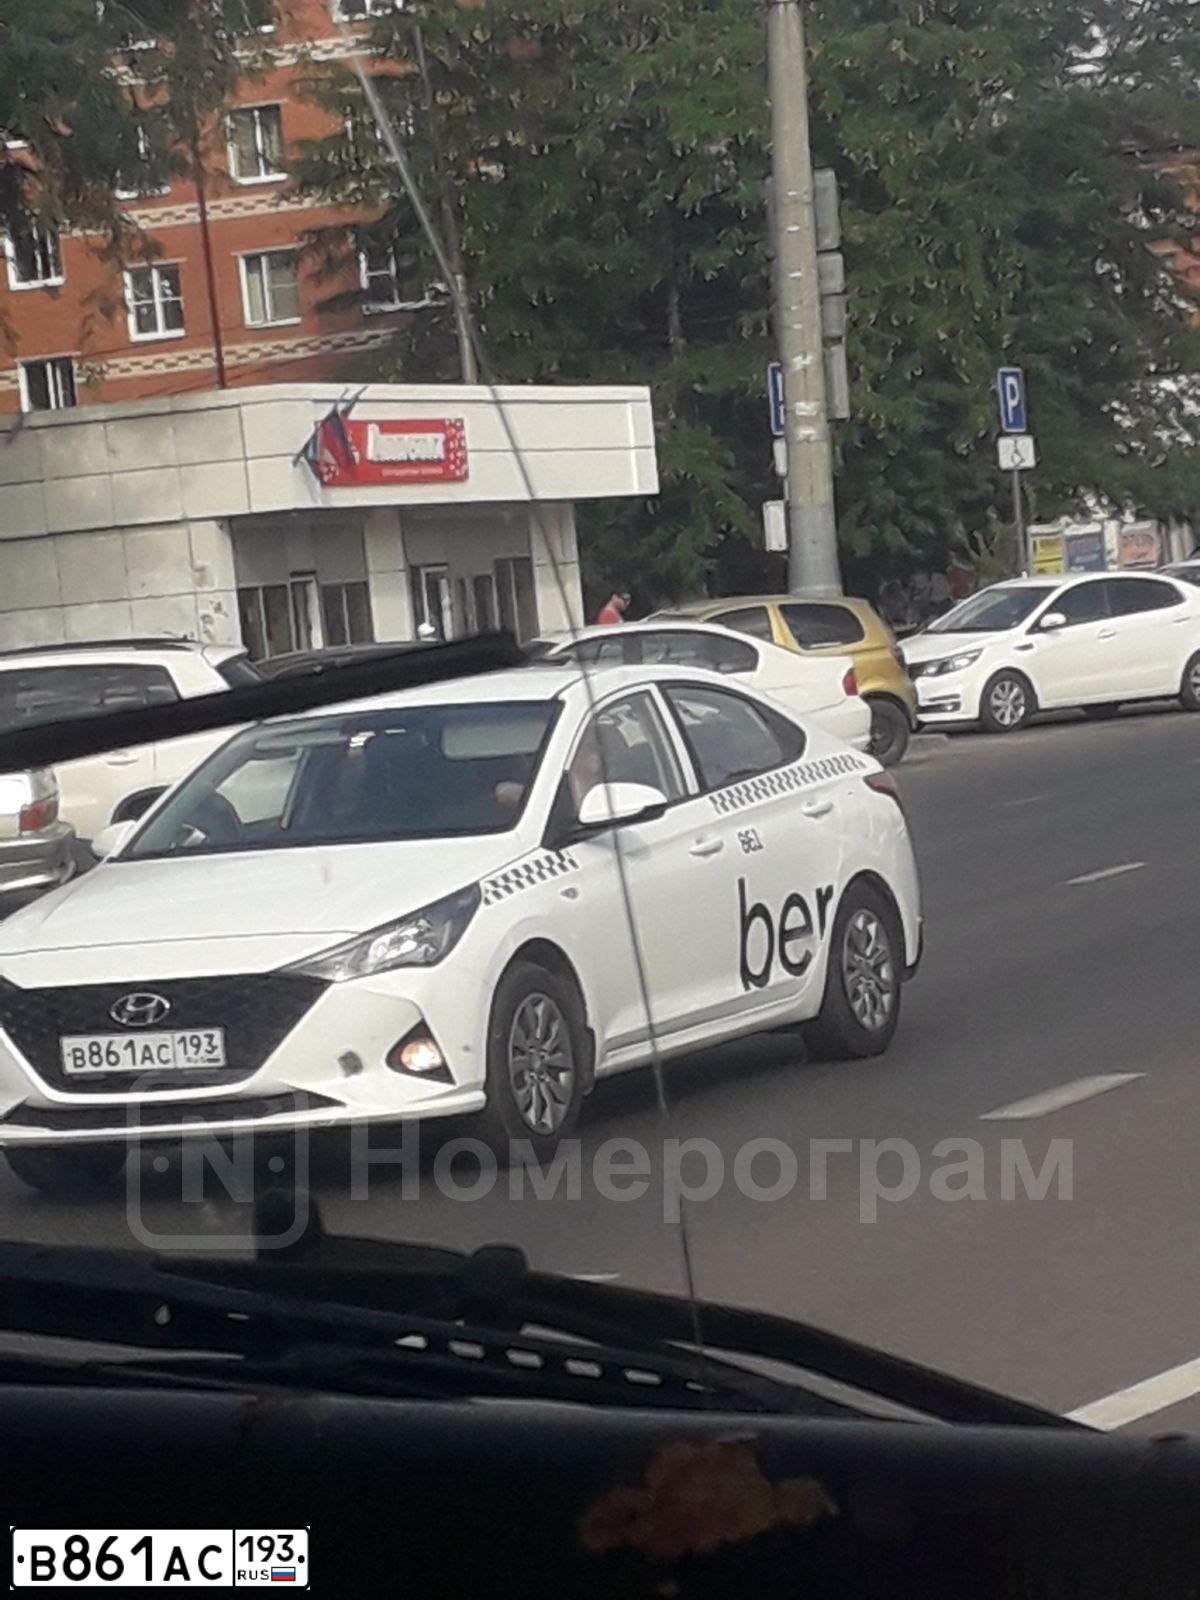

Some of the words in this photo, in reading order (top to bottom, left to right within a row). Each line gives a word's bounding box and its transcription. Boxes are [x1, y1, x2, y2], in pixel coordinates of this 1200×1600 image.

[1005, 376, 1019, 423] P
[738, 878, 833, 991] ber
[177, 1034, 216, 1056] 193
